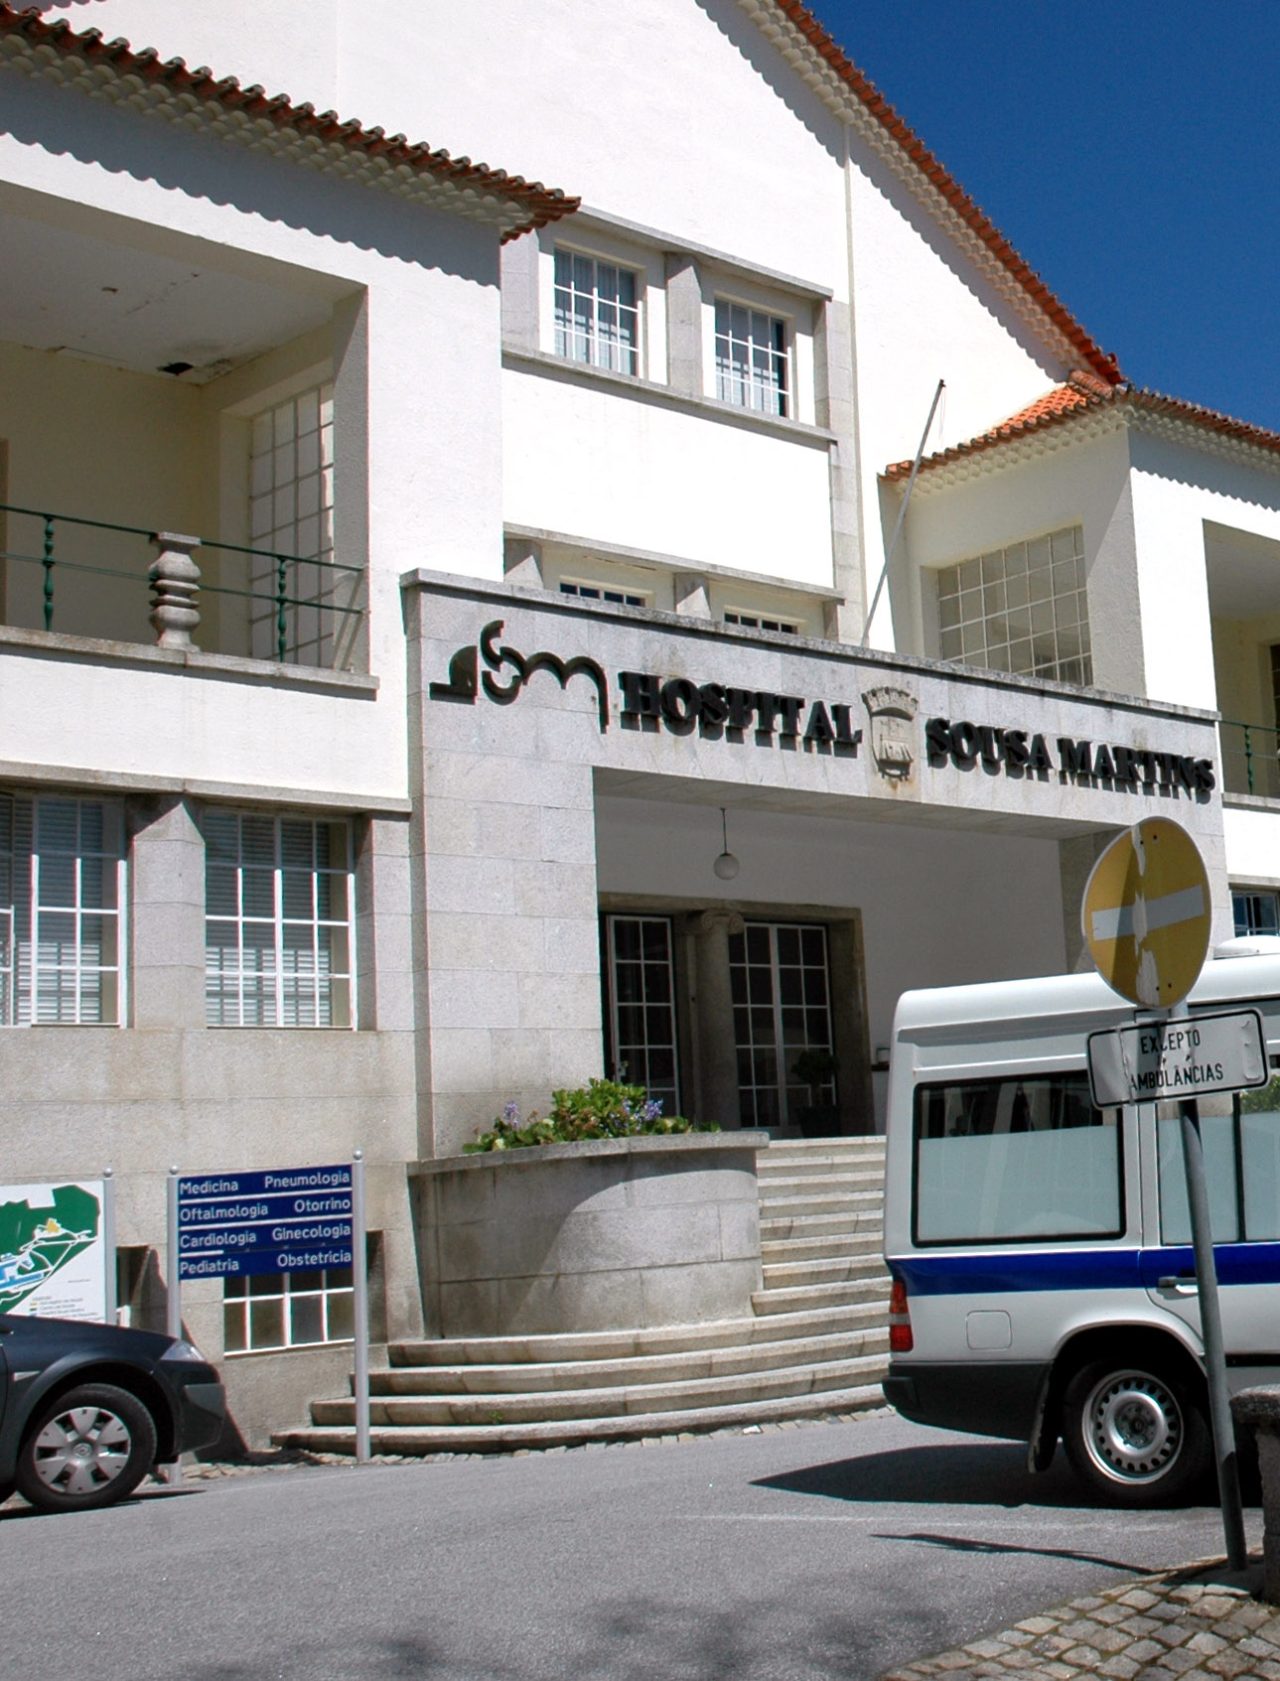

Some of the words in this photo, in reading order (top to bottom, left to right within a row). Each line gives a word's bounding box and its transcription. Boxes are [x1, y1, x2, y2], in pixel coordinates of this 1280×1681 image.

[617, 671, 863, 752] HOSPITAL
[925, 717, 1054, 773] SOUSA
[1056, 737, 1216, 796] MARTINS
[179, 1180, 239, 1195] Medicina
[264, 1170, 350, 1189] Pneumologia
[179, 1203, 269, 1222] Oftalmologia
[294, 1197, 351, 1213] Otorrino
[179, 1230, 257, 1249] Cardiologia
[272, 1223, 351, 1242] Ginecologia
[179, 1258, 240, 1275] Pediatria
